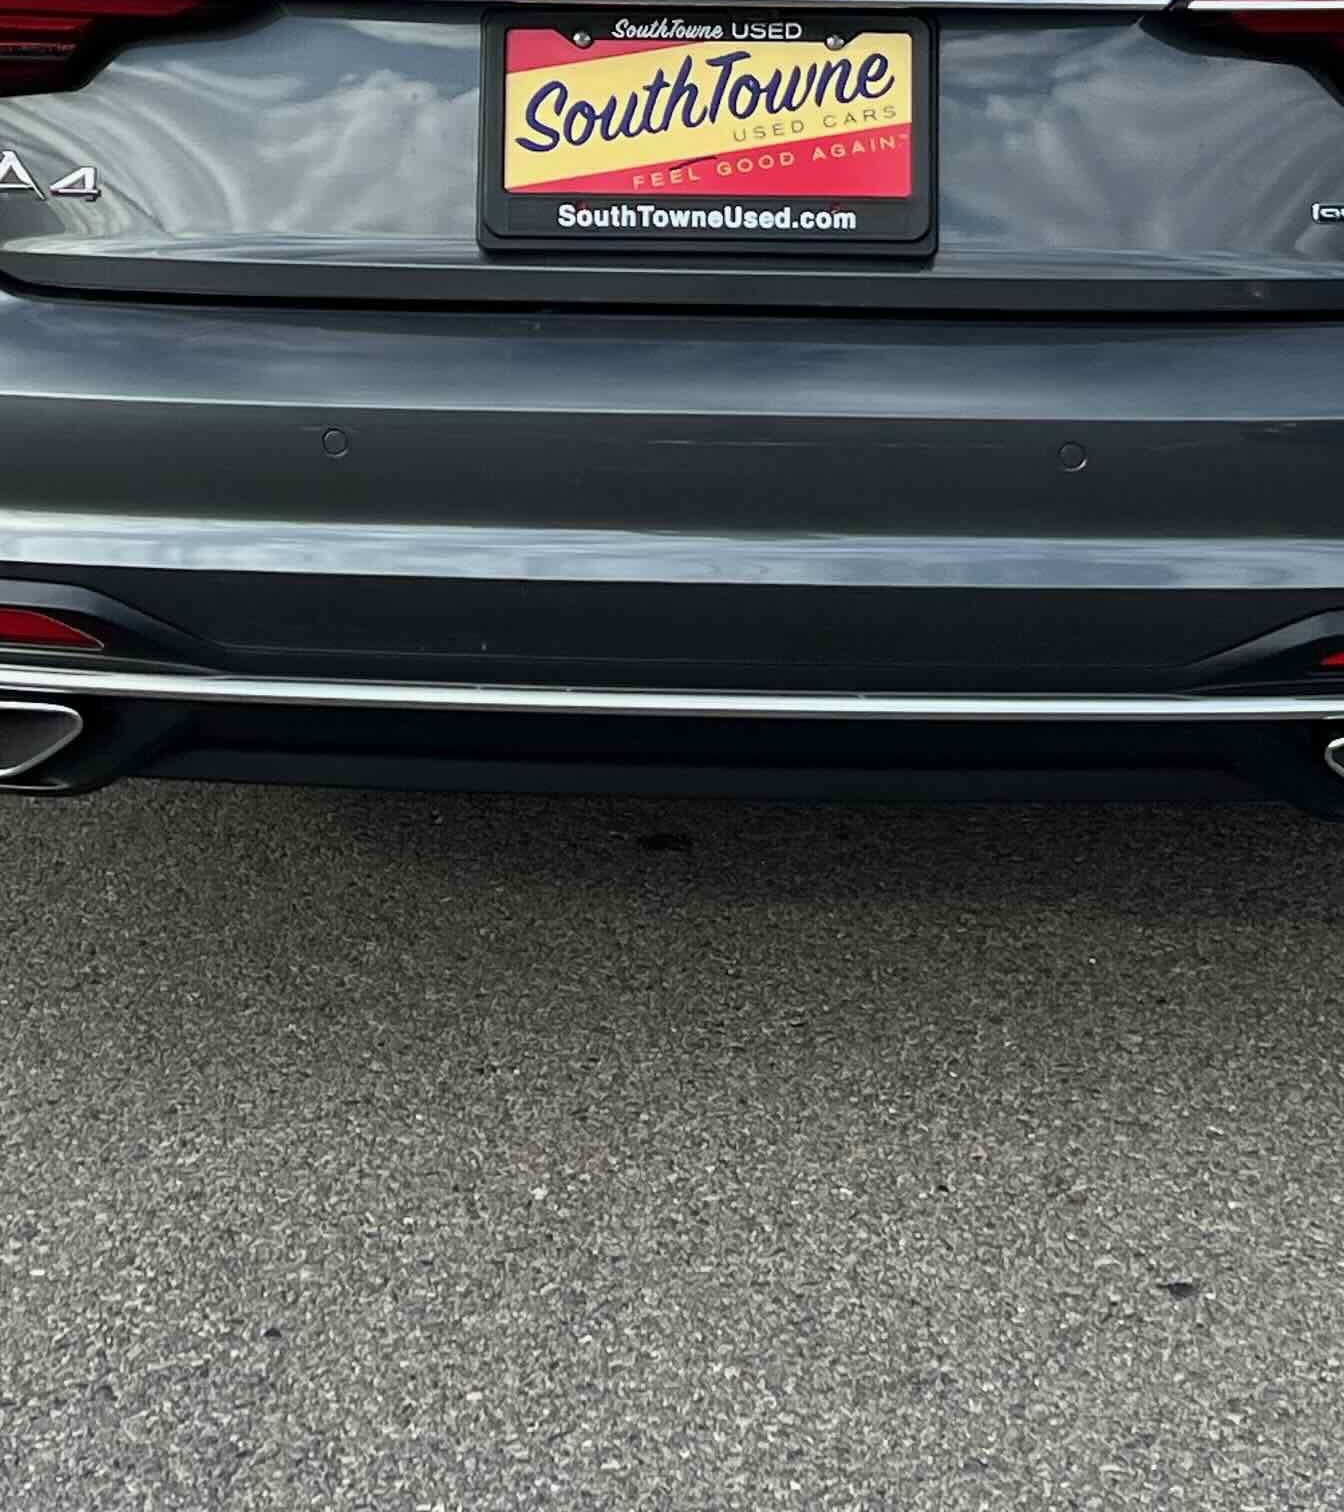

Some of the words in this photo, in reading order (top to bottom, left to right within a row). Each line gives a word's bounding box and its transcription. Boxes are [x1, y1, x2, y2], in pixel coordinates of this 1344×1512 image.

[611, 18, 724, 39] SouthTowne
[731, 22, 803, 40] USED
[515, 51, 895, 152] SouthTowne
[733, 119, 806, 143] USED
[822, 105, 897, 129] CARS
[633, 167, 701, 190] FEEL
[717, 152, 796, 177] GOOD
[557, 204, 857, 230] SouthTowneUsed.com
